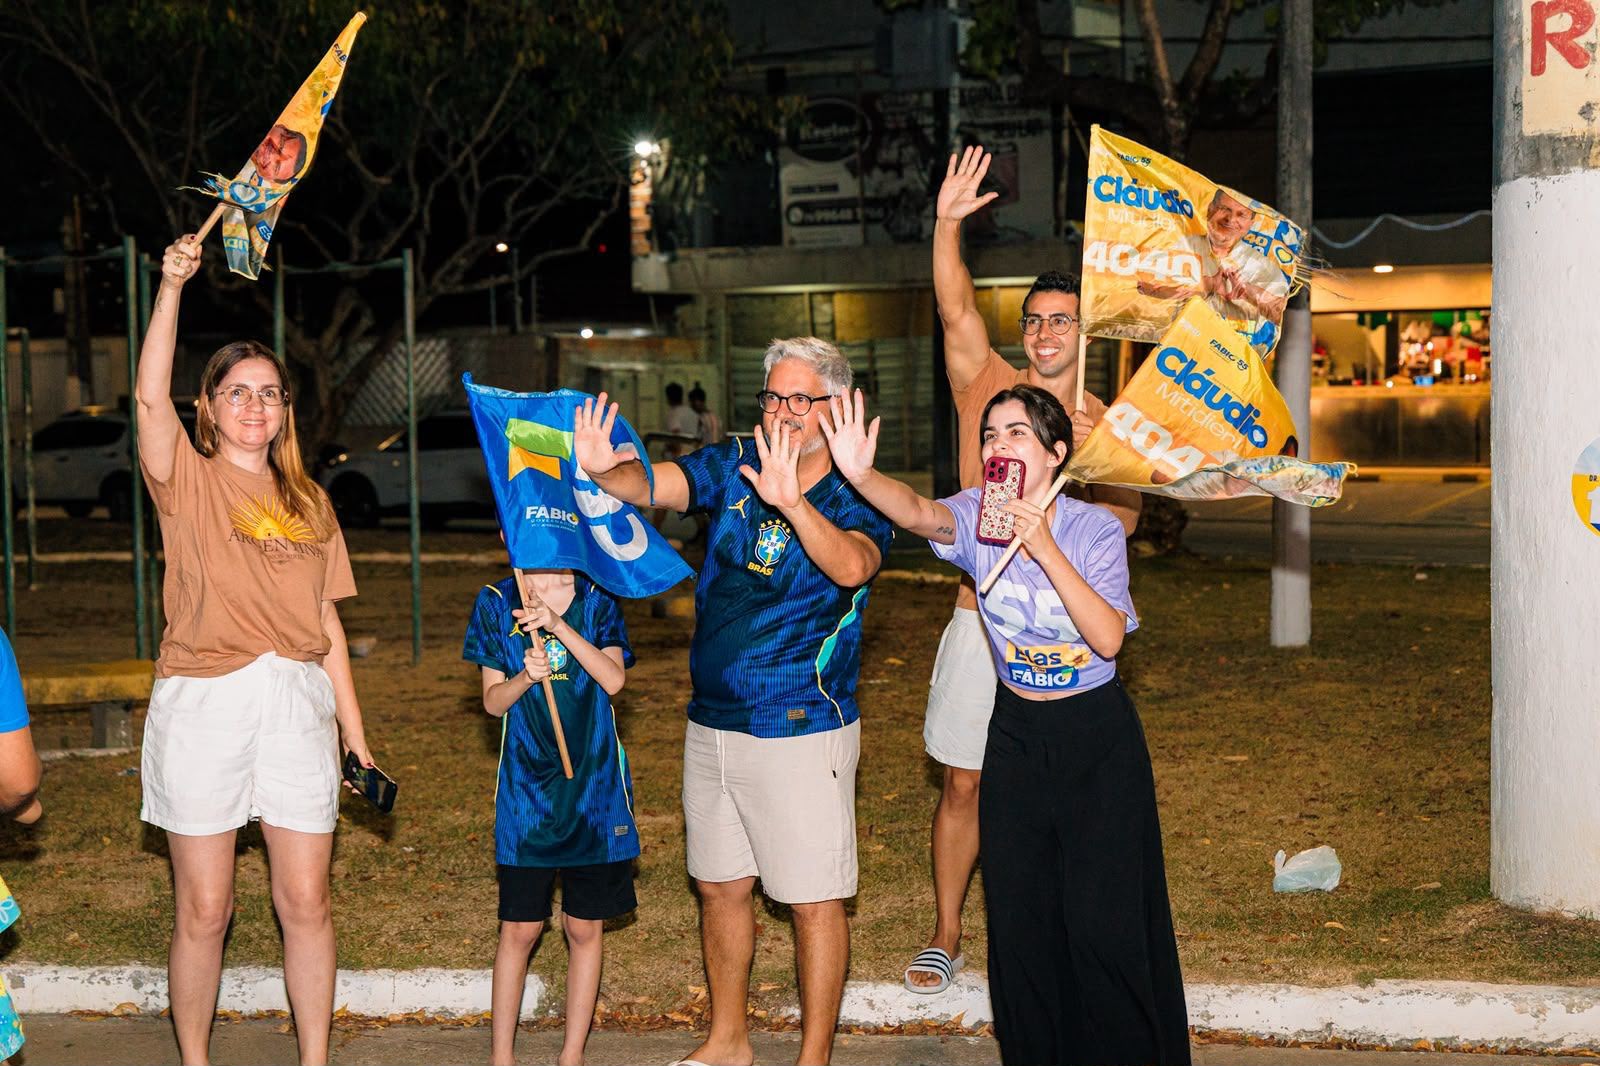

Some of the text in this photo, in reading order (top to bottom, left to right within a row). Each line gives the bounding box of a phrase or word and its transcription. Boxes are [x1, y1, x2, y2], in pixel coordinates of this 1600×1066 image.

[1093, 174, 1194, 219] Cláudio
[1083, 241, 1201, 285] 4040
[1237, 359, 1249, 370] 55
[1156, 346, 1268, 448] Cláudio
[1104, 402, 1207, 480] 404
[549, 673, 569, 681] RASIL
[1011, 667, 1072, 687] FÁBIO
